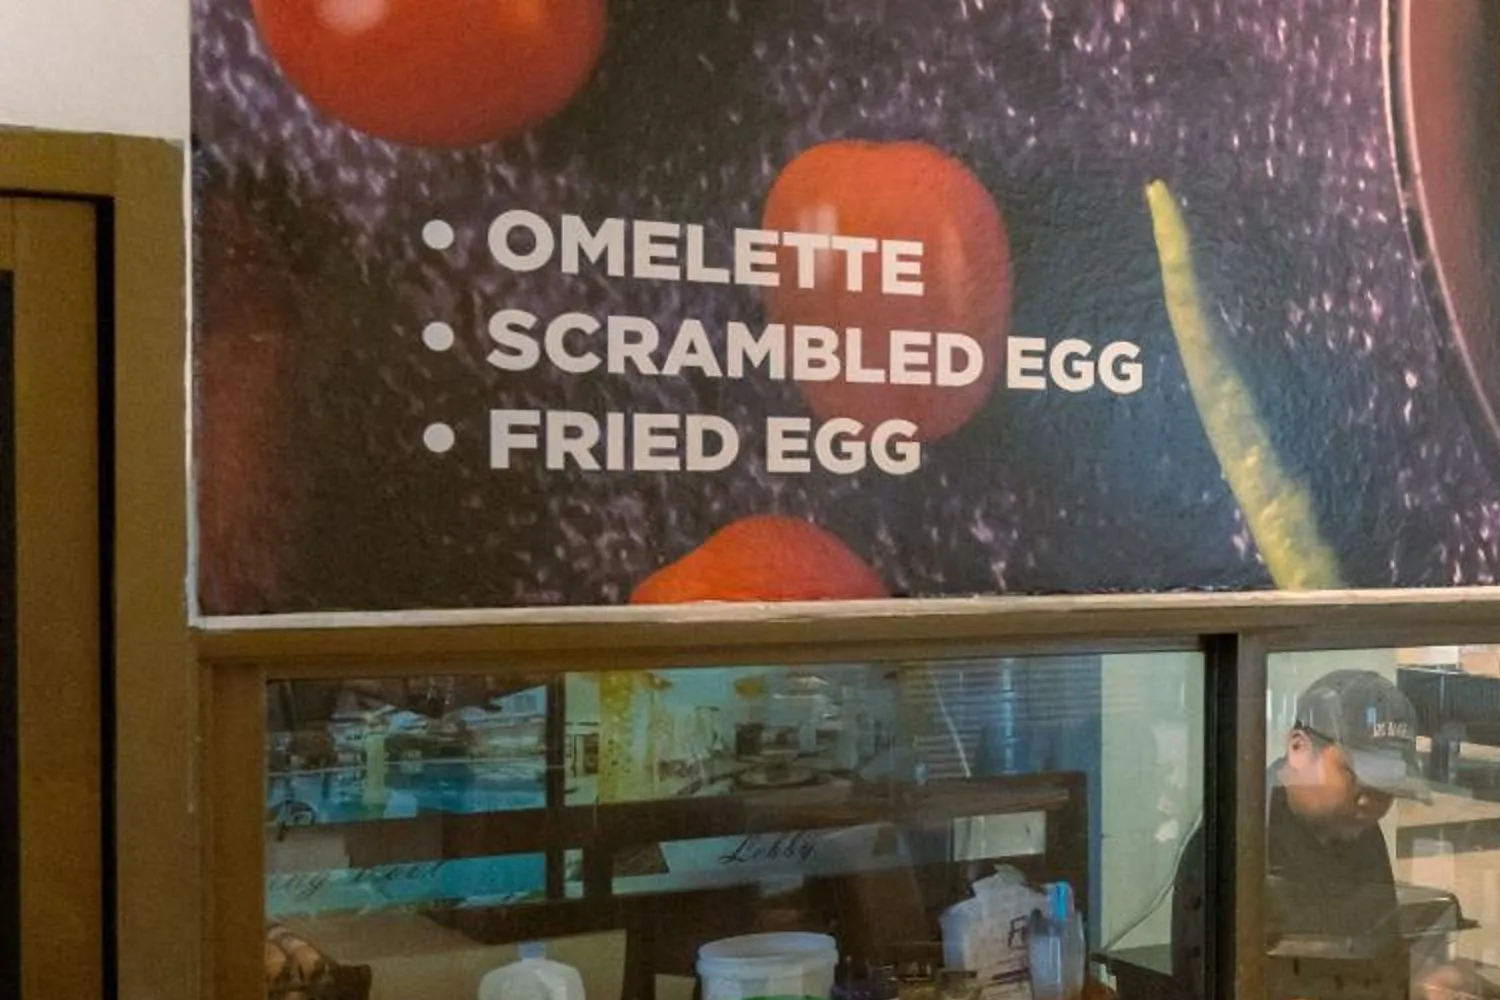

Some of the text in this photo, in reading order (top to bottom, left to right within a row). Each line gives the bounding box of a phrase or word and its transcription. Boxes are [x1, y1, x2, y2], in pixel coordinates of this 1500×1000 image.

[487, 209, 925, 296] OMELETTE
[486, 309, 1143, 395] SCRAMBLED EGG
[489, 408, 923, 476] FRIED EGG
